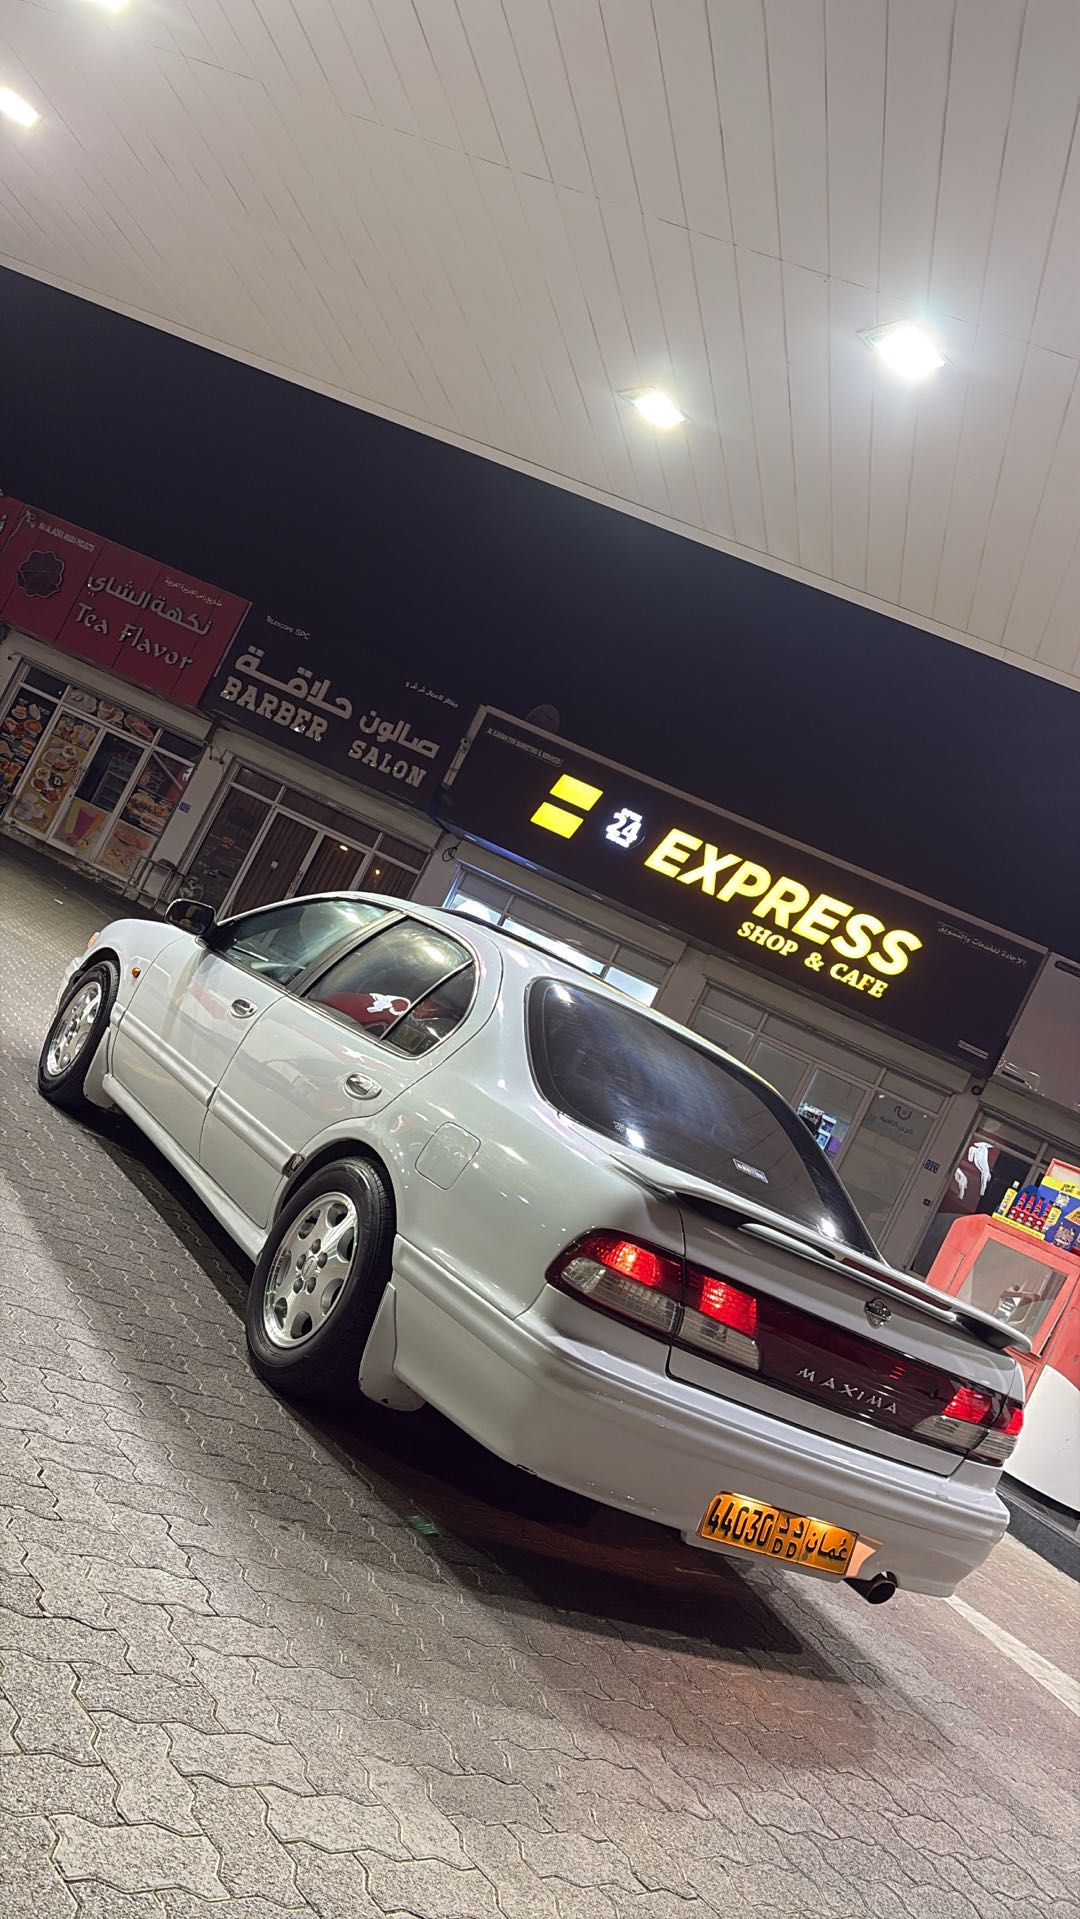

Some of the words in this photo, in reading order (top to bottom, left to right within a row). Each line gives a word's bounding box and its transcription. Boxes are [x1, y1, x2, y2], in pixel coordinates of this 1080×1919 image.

[87, 576, 151, 609] الشاي
[151, 595, 213, 636] نكهة
[76, 603, 109, 635] Tea
[119, 623, 194, 669] Flavor
[294, 628, 311, 640] SPC
[234, 644, 353, 720] حلاقة
[219, 675, 329, 743] BARBER
[347, 739, 428, 789] SALON
[359, 710, 440, 760] صالون
[605, 812, 643, 847] 24
[644, 827, 923, 976] EXPRESS
[737, 920, 799, 957] SHOP
[804, 951, 825, 973] &
[829, 961, 890, 1000] CAFE
[795, 1368, 897, 1415] MAXIMA
[707, 1497, 775, 1547] 44030
